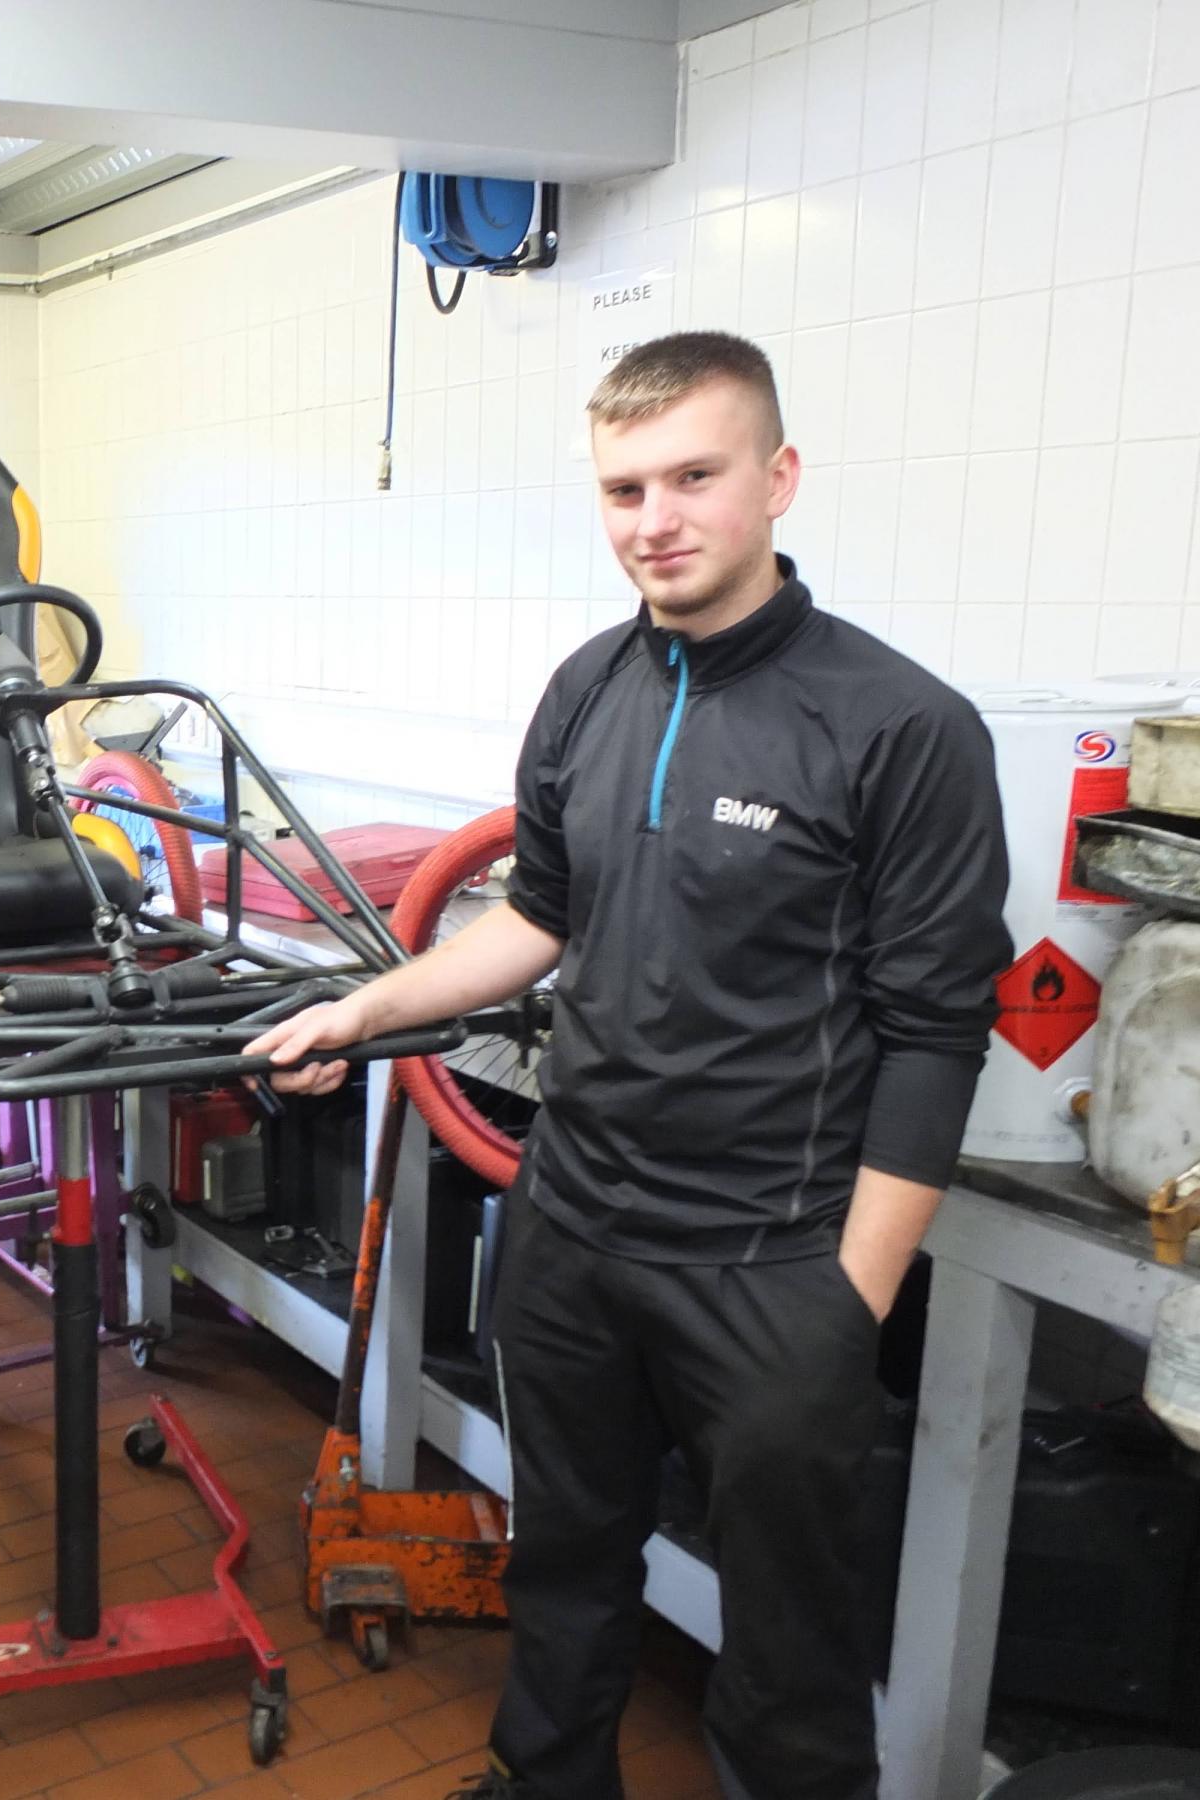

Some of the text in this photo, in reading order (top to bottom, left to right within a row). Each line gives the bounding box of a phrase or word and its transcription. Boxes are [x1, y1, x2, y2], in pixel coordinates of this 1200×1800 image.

[593, 284, 652, 311] PLEASE
[601, 343, 640, 361] KEE
[713, 797, 780, 832] BMW
